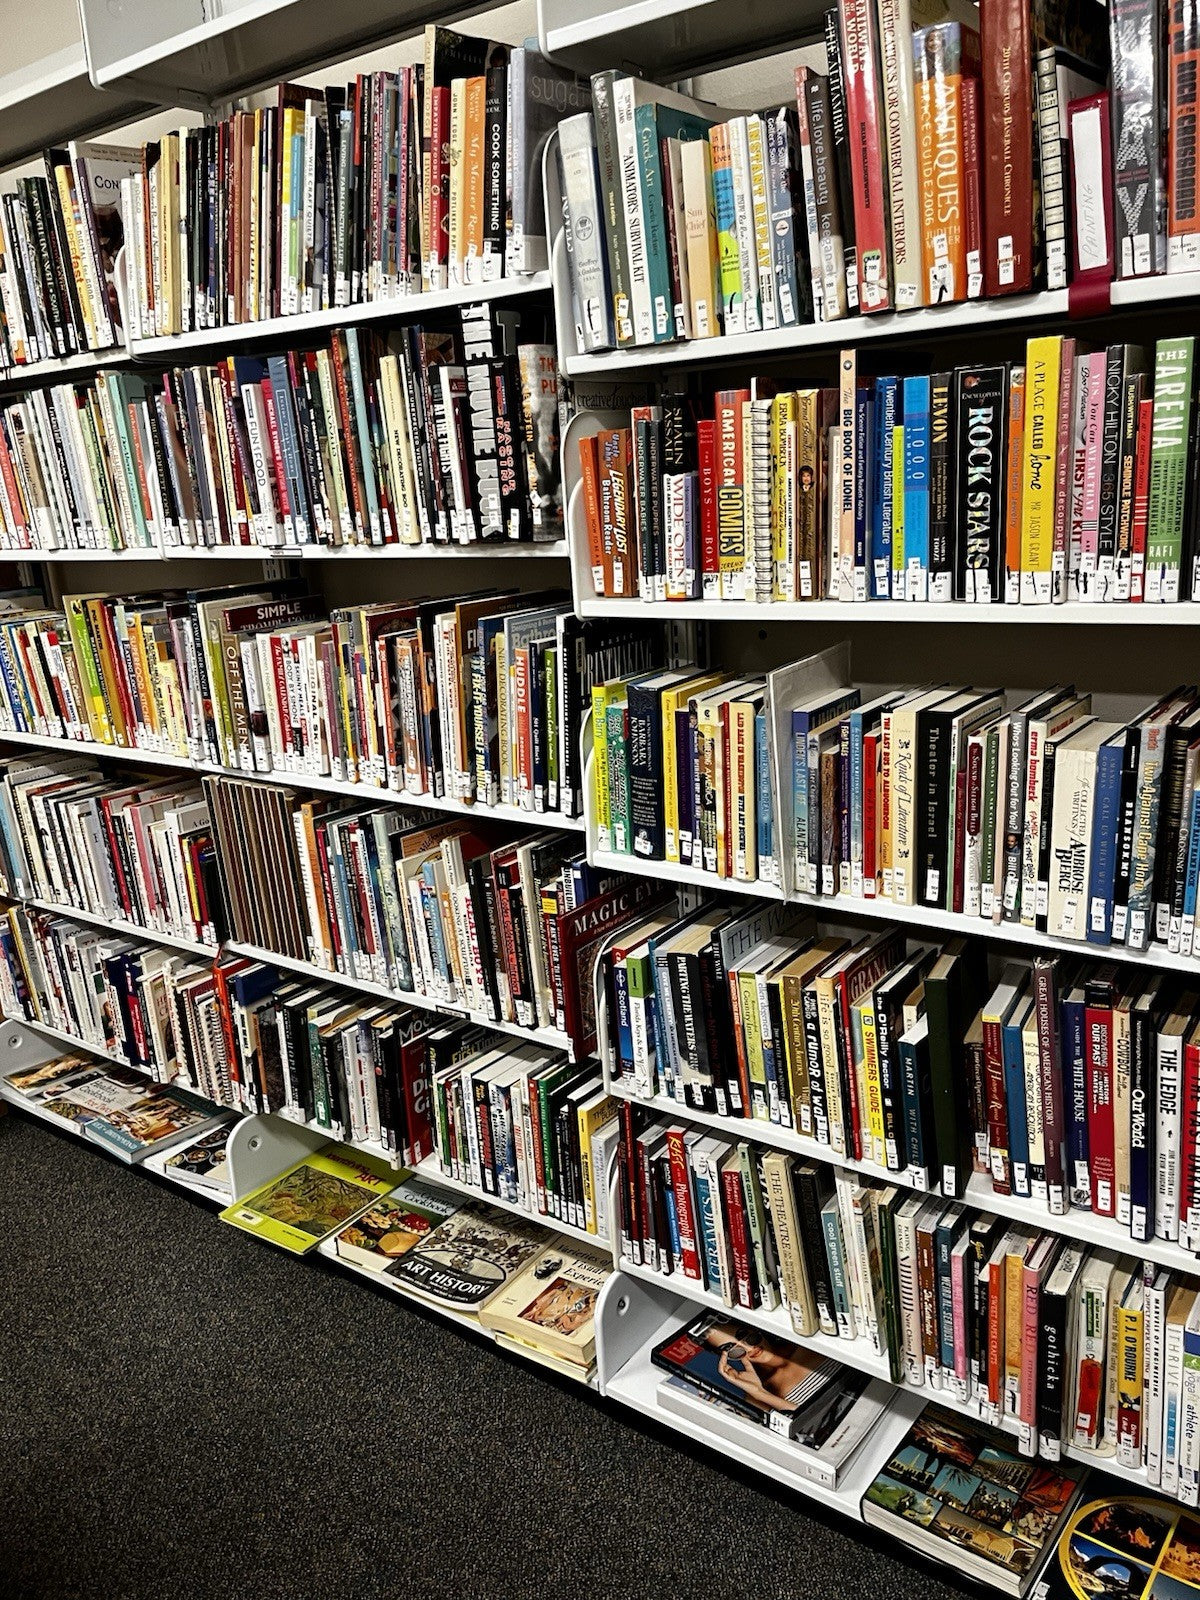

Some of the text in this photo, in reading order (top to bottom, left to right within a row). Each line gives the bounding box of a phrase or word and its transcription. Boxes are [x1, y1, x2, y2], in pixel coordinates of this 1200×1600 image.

[641, 127, 655, 187] Greek Art
[887, 88, 906, 265] FOR COMMERCIAL INTERIORS
[933, 84, 960, 223] ANTIQUES
[1002, 70, 1013, 217] CENTURY BASEBALL CHRONICLE
[491, 162, 499, 230] SOMETHING
[623, 154, 645, 283] ANIMATOR'S SURVIVAL KIT
[749, 121, 770, 267] INSTANT REPLAY
[923, 191, 934, 226] 2006
[1082, 184, 1096, 257] PAINTING
[461, 302, 494, 360] THE
[1156, 350, 1188, 361] THE
[466, 364, 497, 456] MOVIE
[932, 386, 948, 443] LEVON
[962, 392, 1001, 400] ENCYCLOPEDIA
[1029, 360, 1051, 490] A PLACE CALLED home
[1061, 368, 1071, 435] DURWIN RICE
[1152, 366, 1187, 449] ARENA
[254, 454, 265, 486] FOOD
[637, 435, 645, 499] UNDERWATER
[719, 407, 743, 554] AMERICAN COMICS
[842, 409, 853, 513] BIG BOOK OF LIONEL
[882, 383, 897, 544] Twentieth Century Literature
[966, 406, 994, 569] ROCK STARS
[1074, 449, 1086, 489] FIRST
[1100, 360, 1122, 549] NICKY HILTON 365 STYLE
[601, 479, 612, 554] Bathroom Reader
[673, 478, 684, 578] WIDE OPEN
[703, 468, 716, 573] BOYS BOAT
[1029, 501, 1041, 567] MR JASON GRANT
[1072, 520, 1082, 544] KIT
[1118, 454, 1133, 552] SEMINOLE PATCHWORK
[1149, 546, 1173, 557] RAFI
[257, 602, 300, 620] SIMPLE
[226, 646, 243, 709] OFF THE
[515, 656, 526, 713] HUDDLE
[594, 696, 604, 739] Dave Barry
[638, 720, 647, 766] BARBARA
[883, 769, 890, 778] TO
[928, 728, 940, 838] Theater in Israel
[1009, 722, 1022, 830] Who's Looking Out for You?
[1028, 731, 1039, 802] erma bombeck
[796, 817, 806, 836] ALAN
[1072, 791, 1080, 829] WRITINGS
[1079, 788, 1090, 836] COLLECTED
[1136, 762, 1159, 859] Two Against Cape
[1055, 848, 1072, 893] BIERCE
[1070, 837, 1087, 895] AMBROSE
[465, 897, 485, 985] REAL BOYS
[574, 894, 629, 936] MAGIC
[727, 918, 763, 961] THE
[618, 989, 628, 1027] Scotland
[820, 993, 832, 1067] life is so good
[865, 1031, 880, 1115] SWIMMERS GUIDE
[878, 1014, 890, 1089] O'Reilly factor
[1038, 976, 1054, 1126] GREAT HOUSES OF AMERICAN HISTORY
[1092, 1024, 1100, 1066] OUR PAST
[812, 1080, 821, 1094] of
[904, 1056, 918, 1135] MARTIN WITH
[1073, 1058, 1085, 1123] WHITE HOUSE
[1160, 1049, 1178, 1116] THE LEDGE
[355, 1169, 386, 1186] ART
[770, 1171, 790, 1251] THE THEATRE
[401, 1260, 490, 1295] ART HISTORY
[827, 1222, 845, 1288] cool green stuff
[1024, 1284, 1039, 1354] RED RED
[1124, 1315, 1137, 1325] P.
[1154, 1334, 1159, 1343] OF
[1043, 1324, 1060, 1391] gothicka
[1124, 1337, 1137, 1382] O'ROURKE
[1152, 1345, 1160, 1398] ENGINEERING
[1185, 1404, 1199, 1438] athlete
